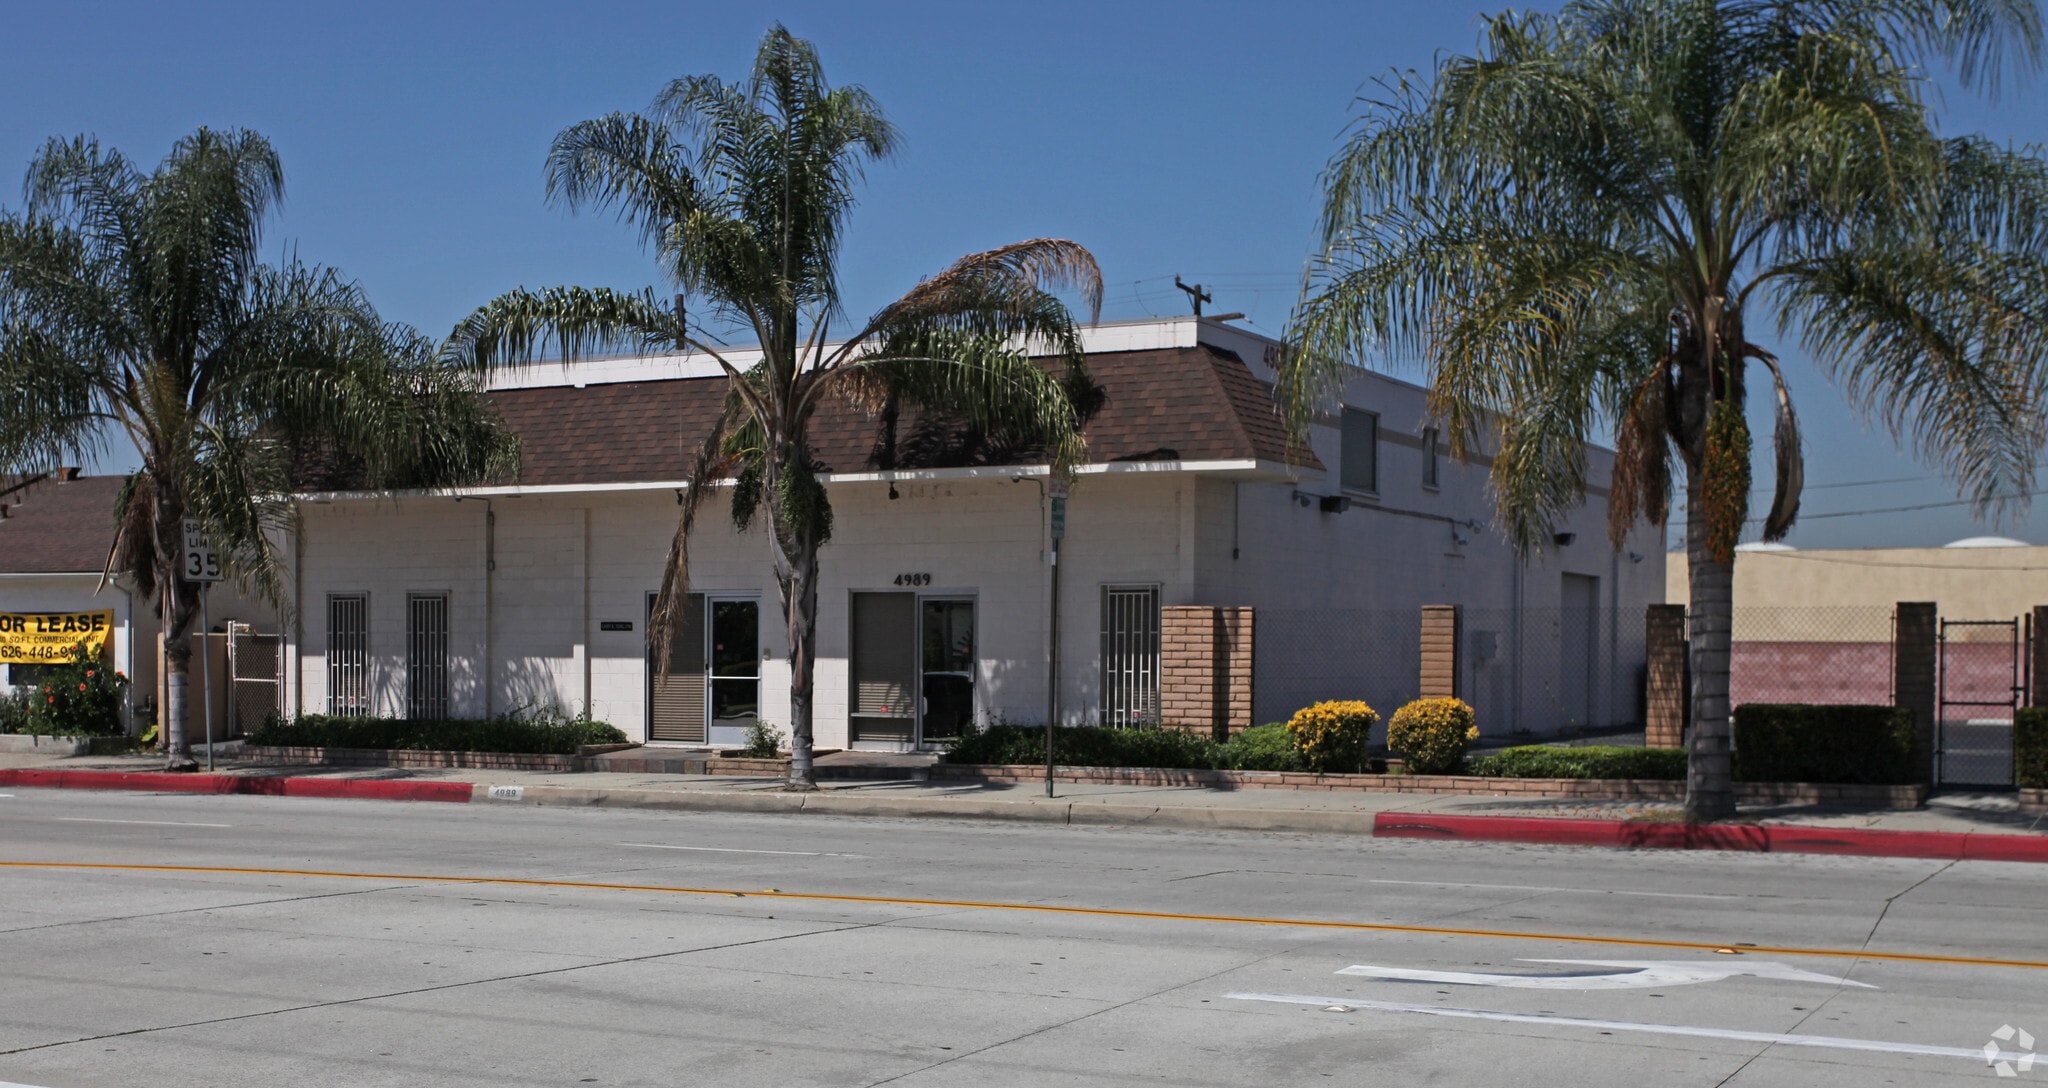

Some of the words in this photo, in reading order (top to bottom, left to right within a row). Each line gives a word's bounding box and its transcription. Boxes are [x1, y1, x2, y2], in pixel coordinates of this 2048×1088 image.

[188, 552, 220, 576] 35
[893, 573, 931, 586] 4989
[0, 615, 25, 632] OR
[36, 614, 105, 632] LEASE
[34, 635, 79, 643] COMMERCIAL
[1, 645, 92, 658] 626-448-9
